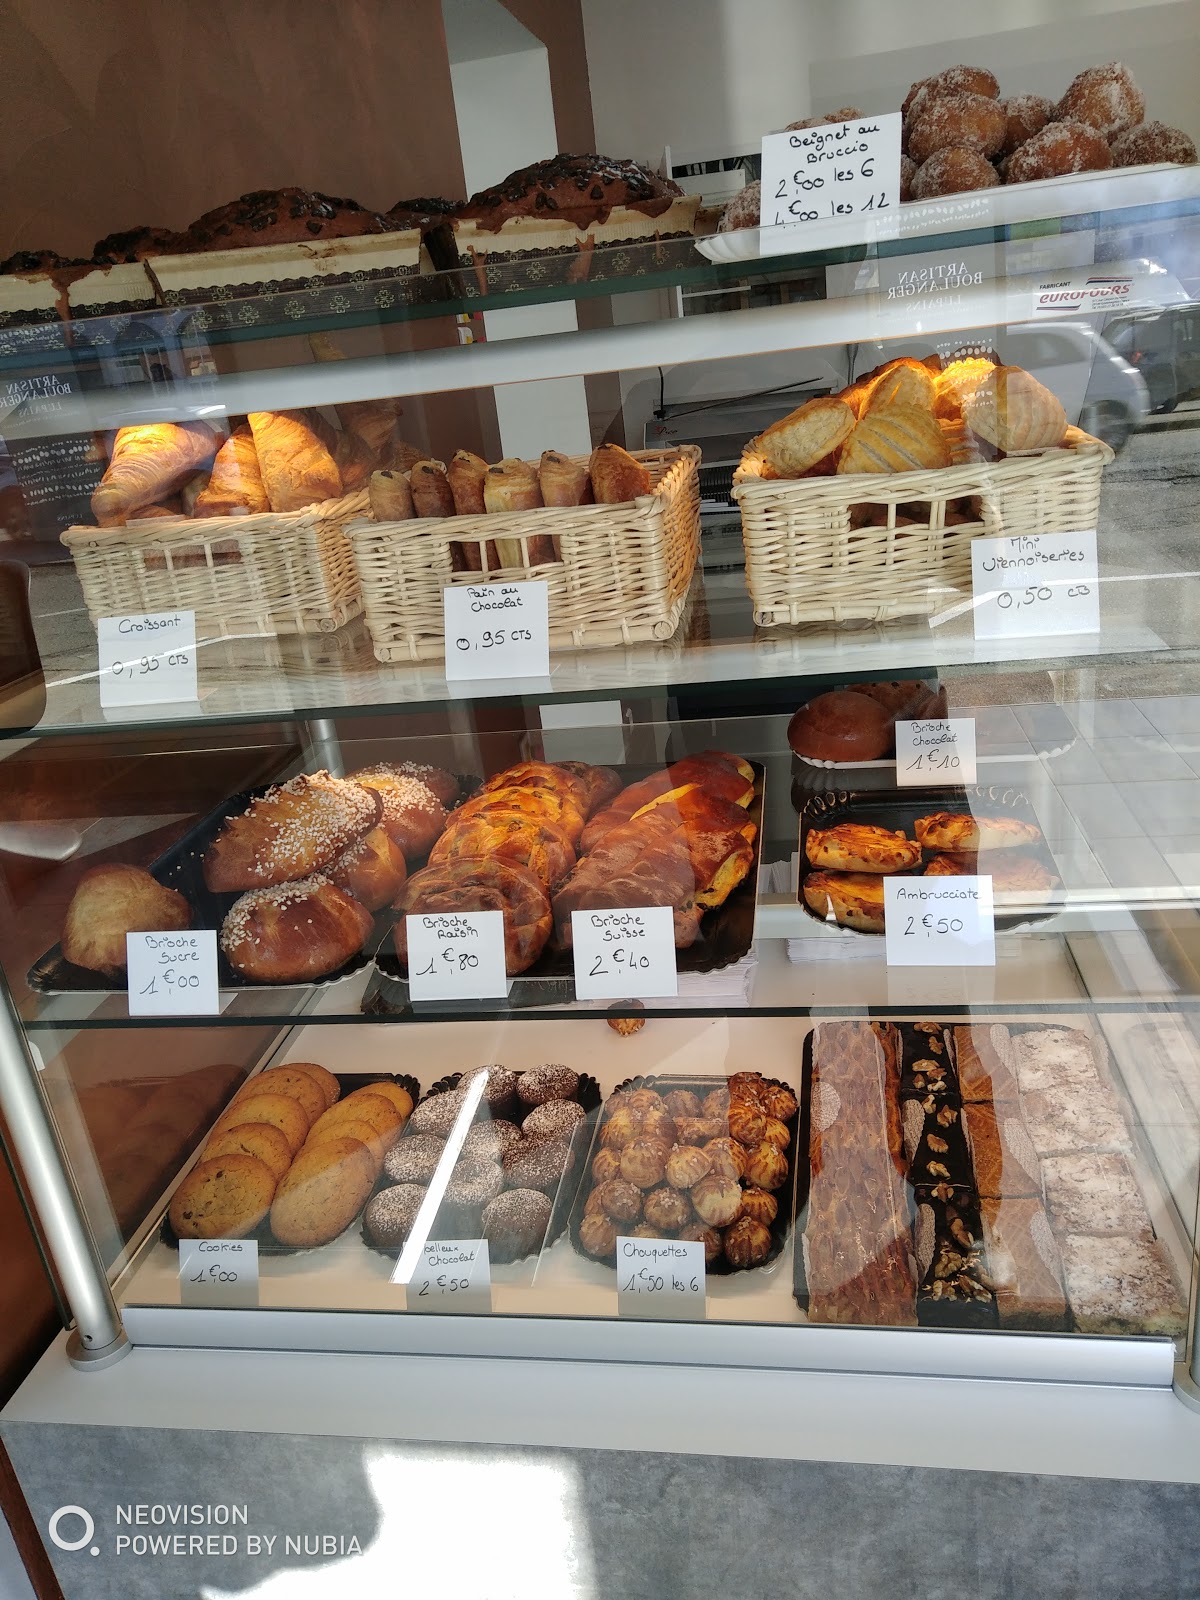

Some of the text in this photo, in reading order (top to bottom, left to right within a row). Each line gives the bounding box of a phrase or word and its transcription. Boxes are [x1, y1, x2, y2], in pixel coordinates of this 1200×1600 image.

[790, 124, 880, 151] Beignet au
[807, 140, 868, 163] Bruccio
[834, 167, 854, 181] les
[861, 158, 874, 177] 6
[831, 200, 853, 215] les
[861, 192, 889, 211] 12
[1040, 281, 1071, 290] FABRICANT
[1010, 536, 1040, 552] Mini
[467, 587, 518, 598] Pain au
[997, 586, 1052, 608] 0,50
[471, 597, 523, 612] Chocolat
[119, 614, 181, 633] Croissant
[456, 630, 505, 650] 0,95
[112, 656, 159, 678] 0,95
[911, 721, 951, 733] Brioche
[897, 888, 981, 900] Ambrucciate
[422, 916, 468, 928] Brioche
[591, 913, 645, 927] Brioche
[437, 926, 478, 939] Raisin
[602, 927, 645, 941] Suisse
[145, 935, 198, 948] Brioche
[158, 952, 199, 964] Sucre
[199, 1241, 243, 1252] Cookies
[423, 1242, 459, 1255] oelleux
[623, 1242, 688, 1263] Chouquettes
[429, 1250, 475, 1266] Chocolat
[672, 1274, 685, 1292] les
[690, 1276, 699, 1292] 6
